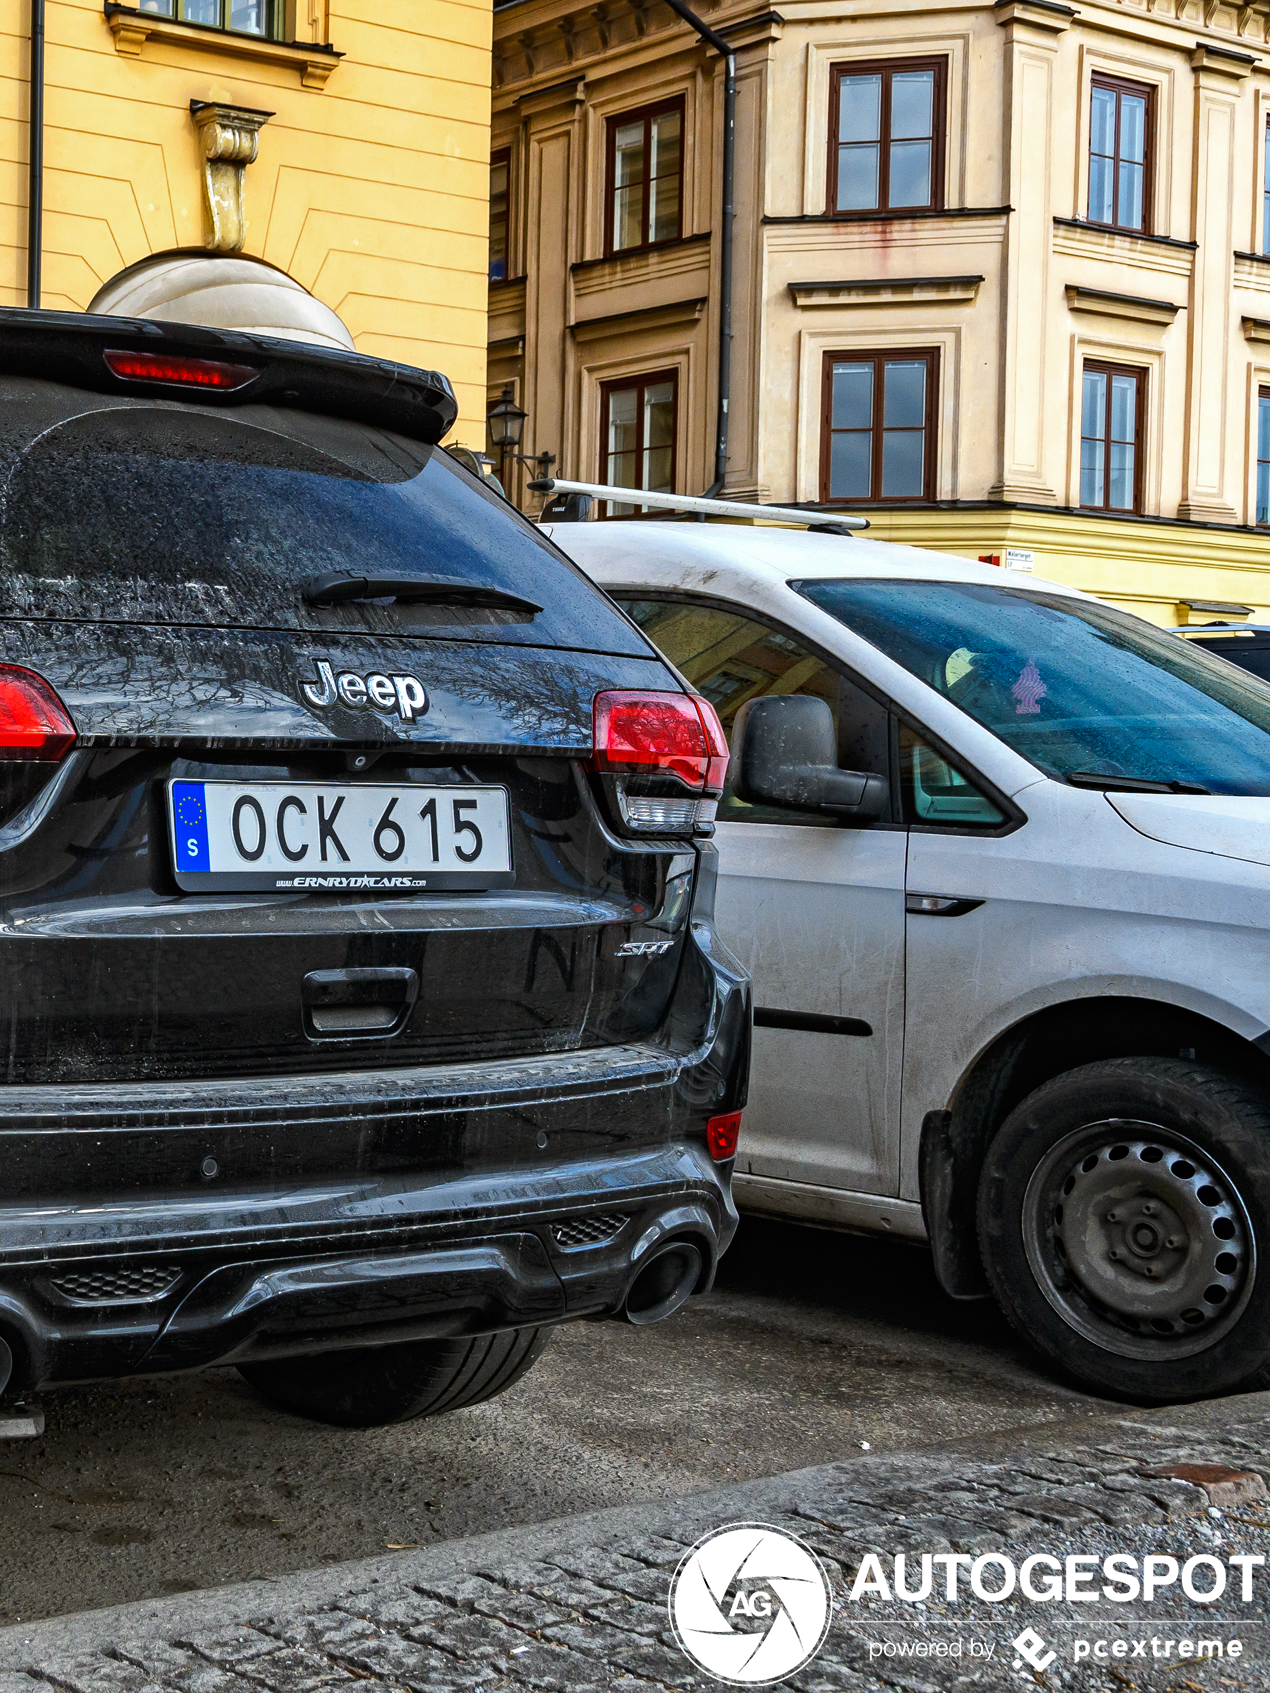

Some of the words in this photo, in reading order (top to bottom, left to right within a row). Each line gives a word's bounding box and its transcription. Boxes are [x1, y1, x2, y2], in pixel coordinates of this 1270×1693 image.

[299, 658, 429, 724] Jeep
[187, 838, 199, 857] S
[231, 794, 351, 863] OCK
[372, 797, 483, 863] 615
[614, 940, 675, 957] SRT
